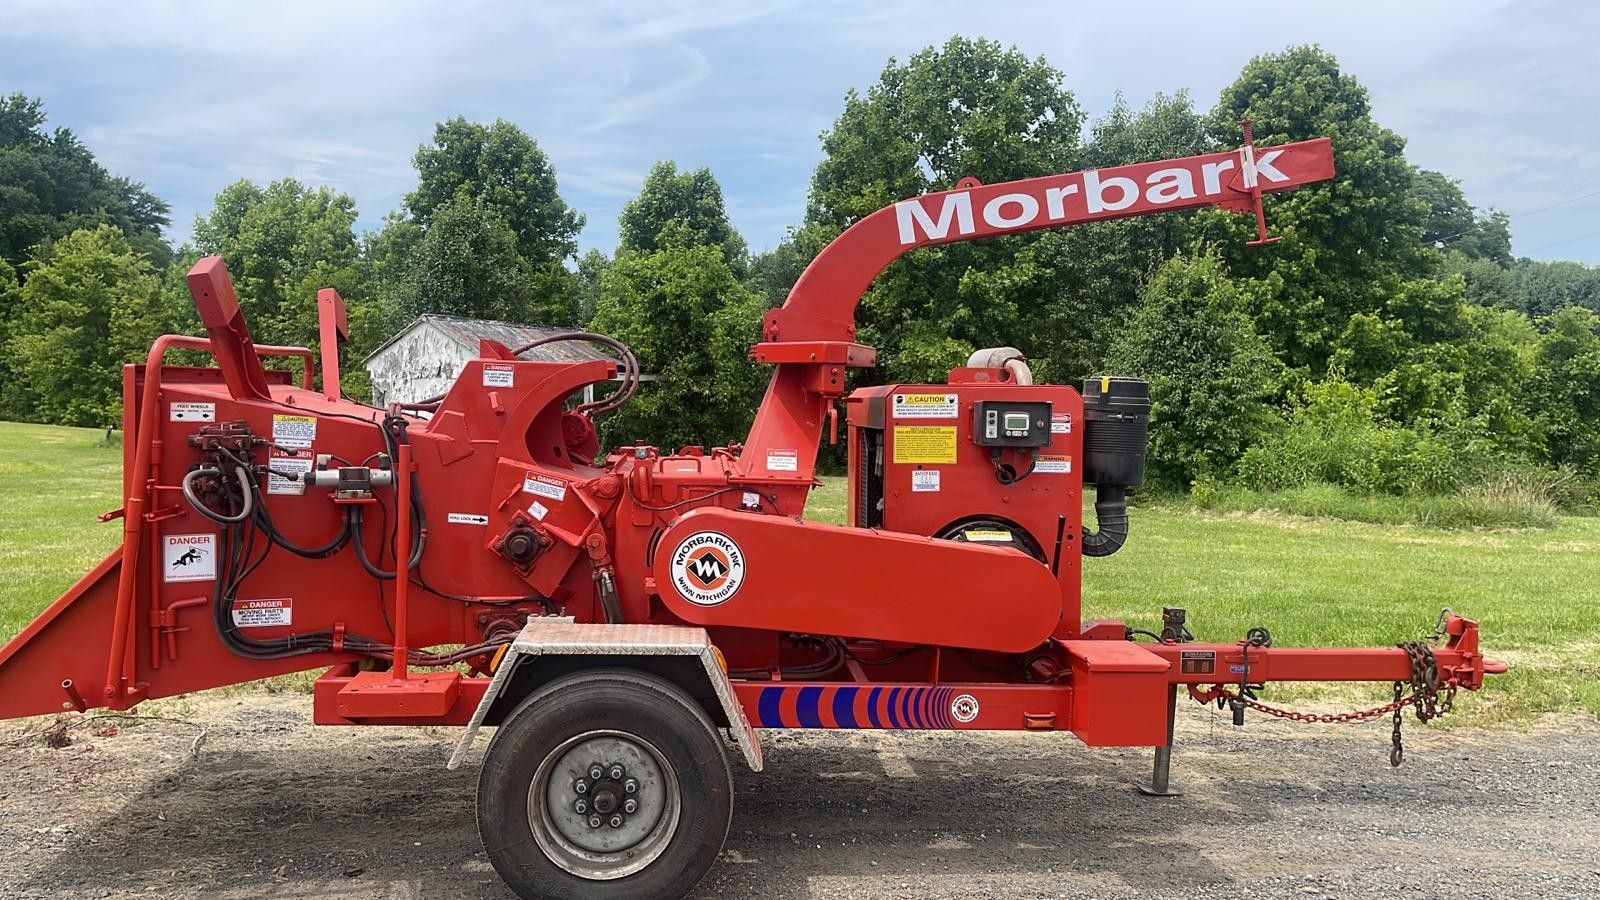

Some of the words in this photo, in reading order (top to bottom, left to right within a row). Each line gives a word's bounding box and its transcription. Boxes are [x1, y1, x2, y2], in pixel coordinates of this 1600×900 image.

[895, 146, 1290, 245] Morbark
[537, 475, 564, 486] DANGER
[169, 536, 210, 545] DANGER
[678, 576, 695, 597] WINN
[695, 578, 737, 601] MICHIGAN
[249, 600, 283, 609] DANGER
